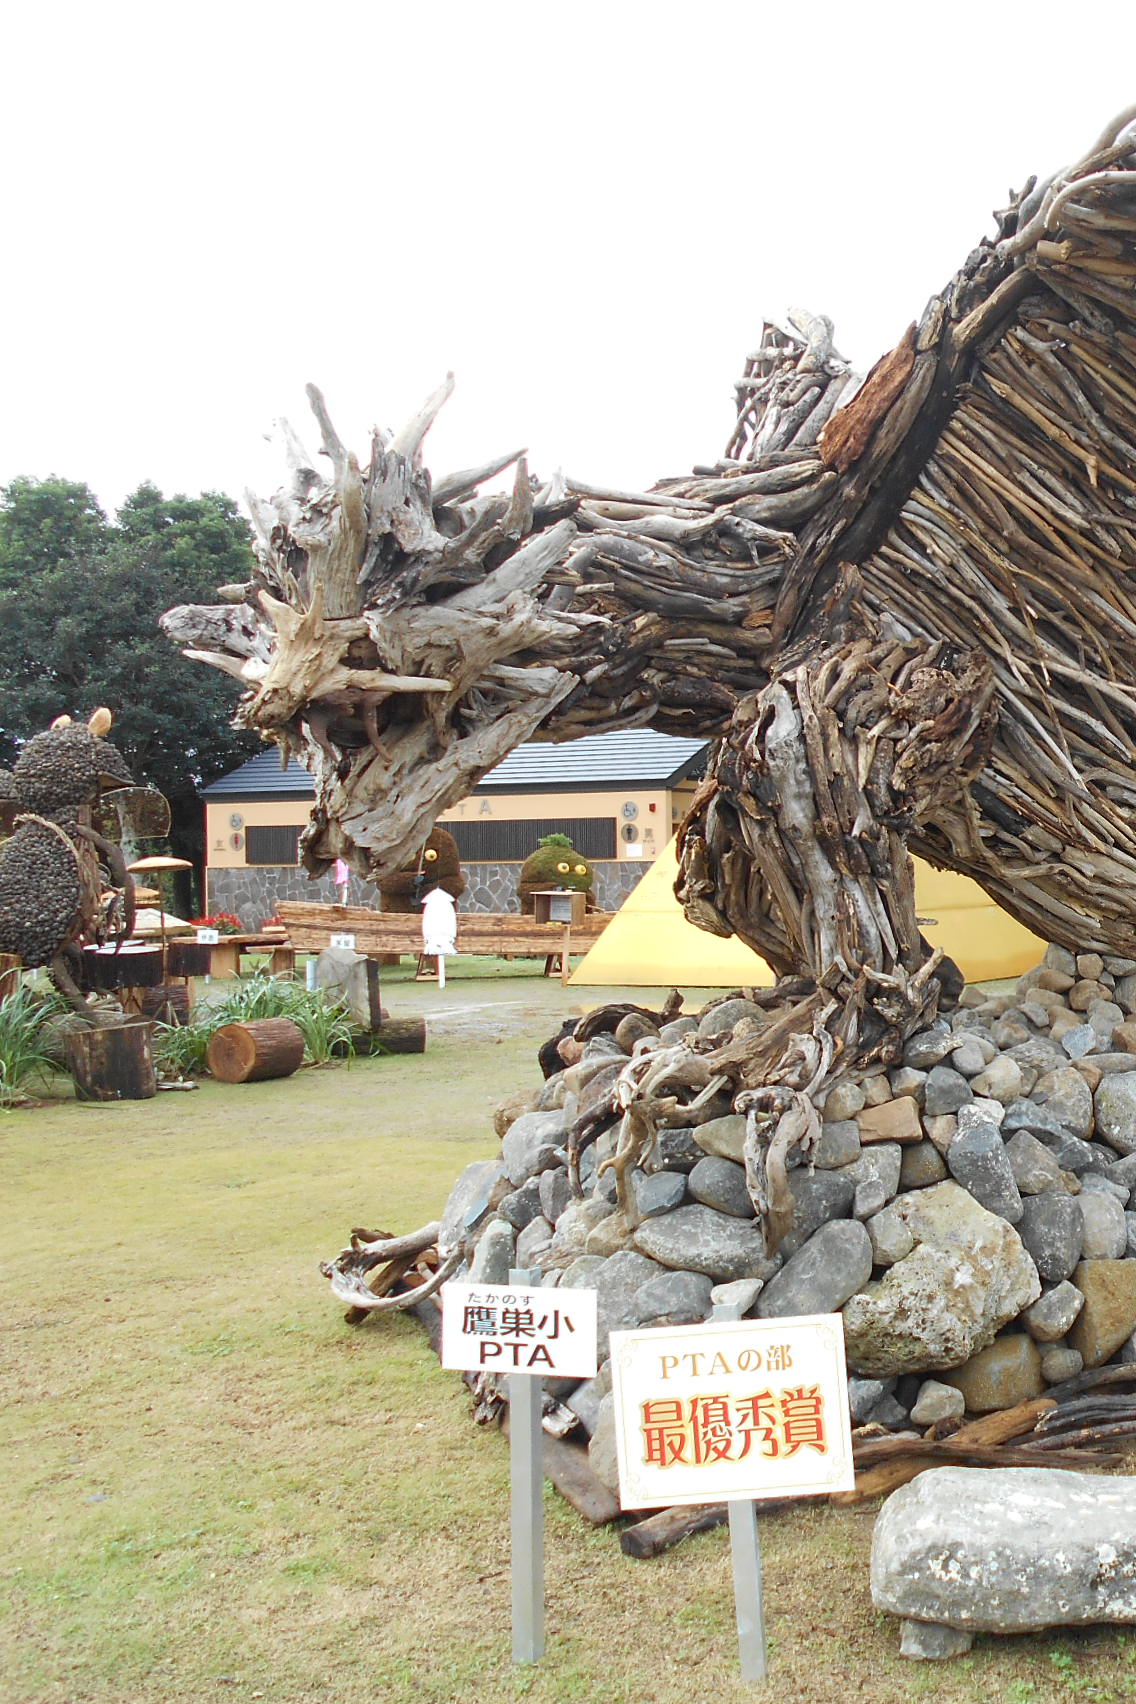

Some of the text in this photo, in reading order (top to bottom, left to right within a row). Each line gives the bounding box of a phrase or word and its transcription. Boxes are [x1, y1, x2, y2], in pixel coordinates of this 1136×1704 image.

[467, 1292, 535, 1306] たかのす
[462, 1305, 576, 1340] 鷹巣小
[479, 1341, 556, 1369] PTA
[658, 1344, 794, 1380] PTAの部
[641, 1384, 829, 1469] 最優秀賞
